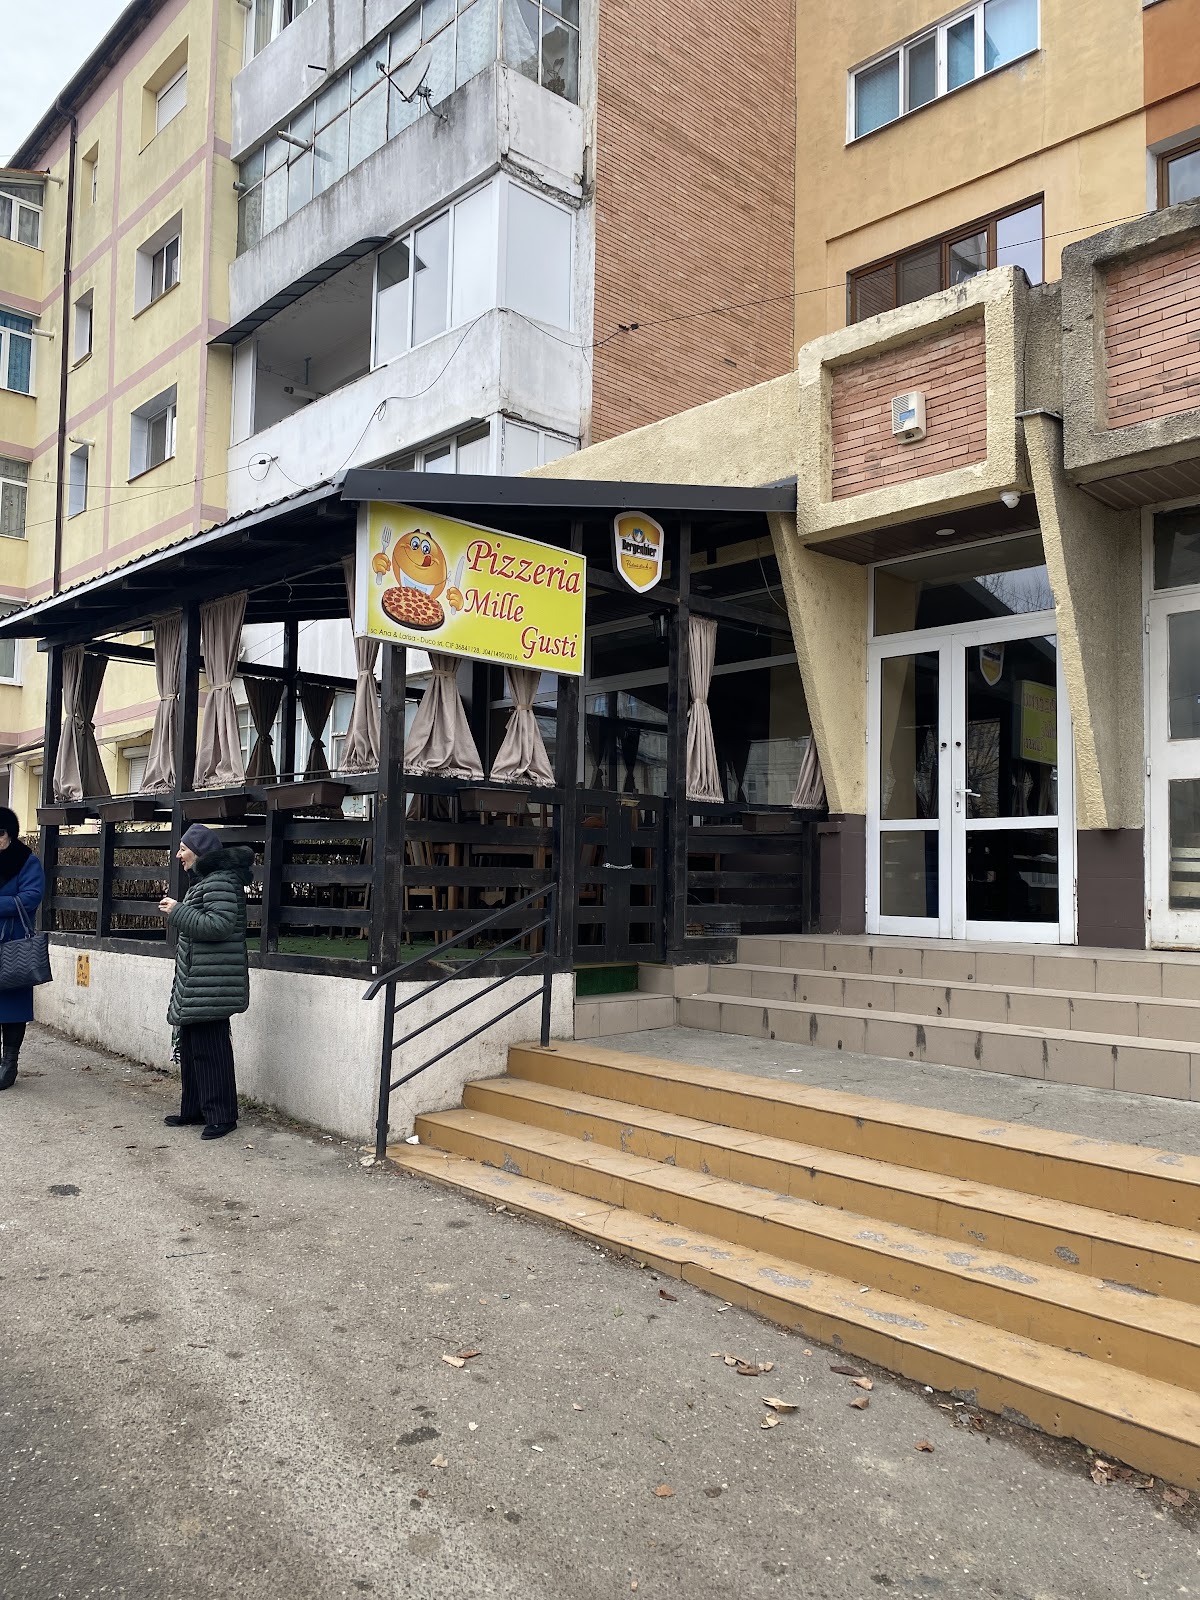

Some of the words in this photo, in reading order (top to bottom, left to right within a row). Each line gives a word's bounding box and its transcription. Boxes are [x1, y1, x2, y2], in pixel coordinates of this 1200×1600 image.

[466, 539, 581, 594] Pizzeria
[464, 588, 525, 623] Mille
[445, 641, 454, 649] CIF
[521, 626, 578, 659] Gusti
